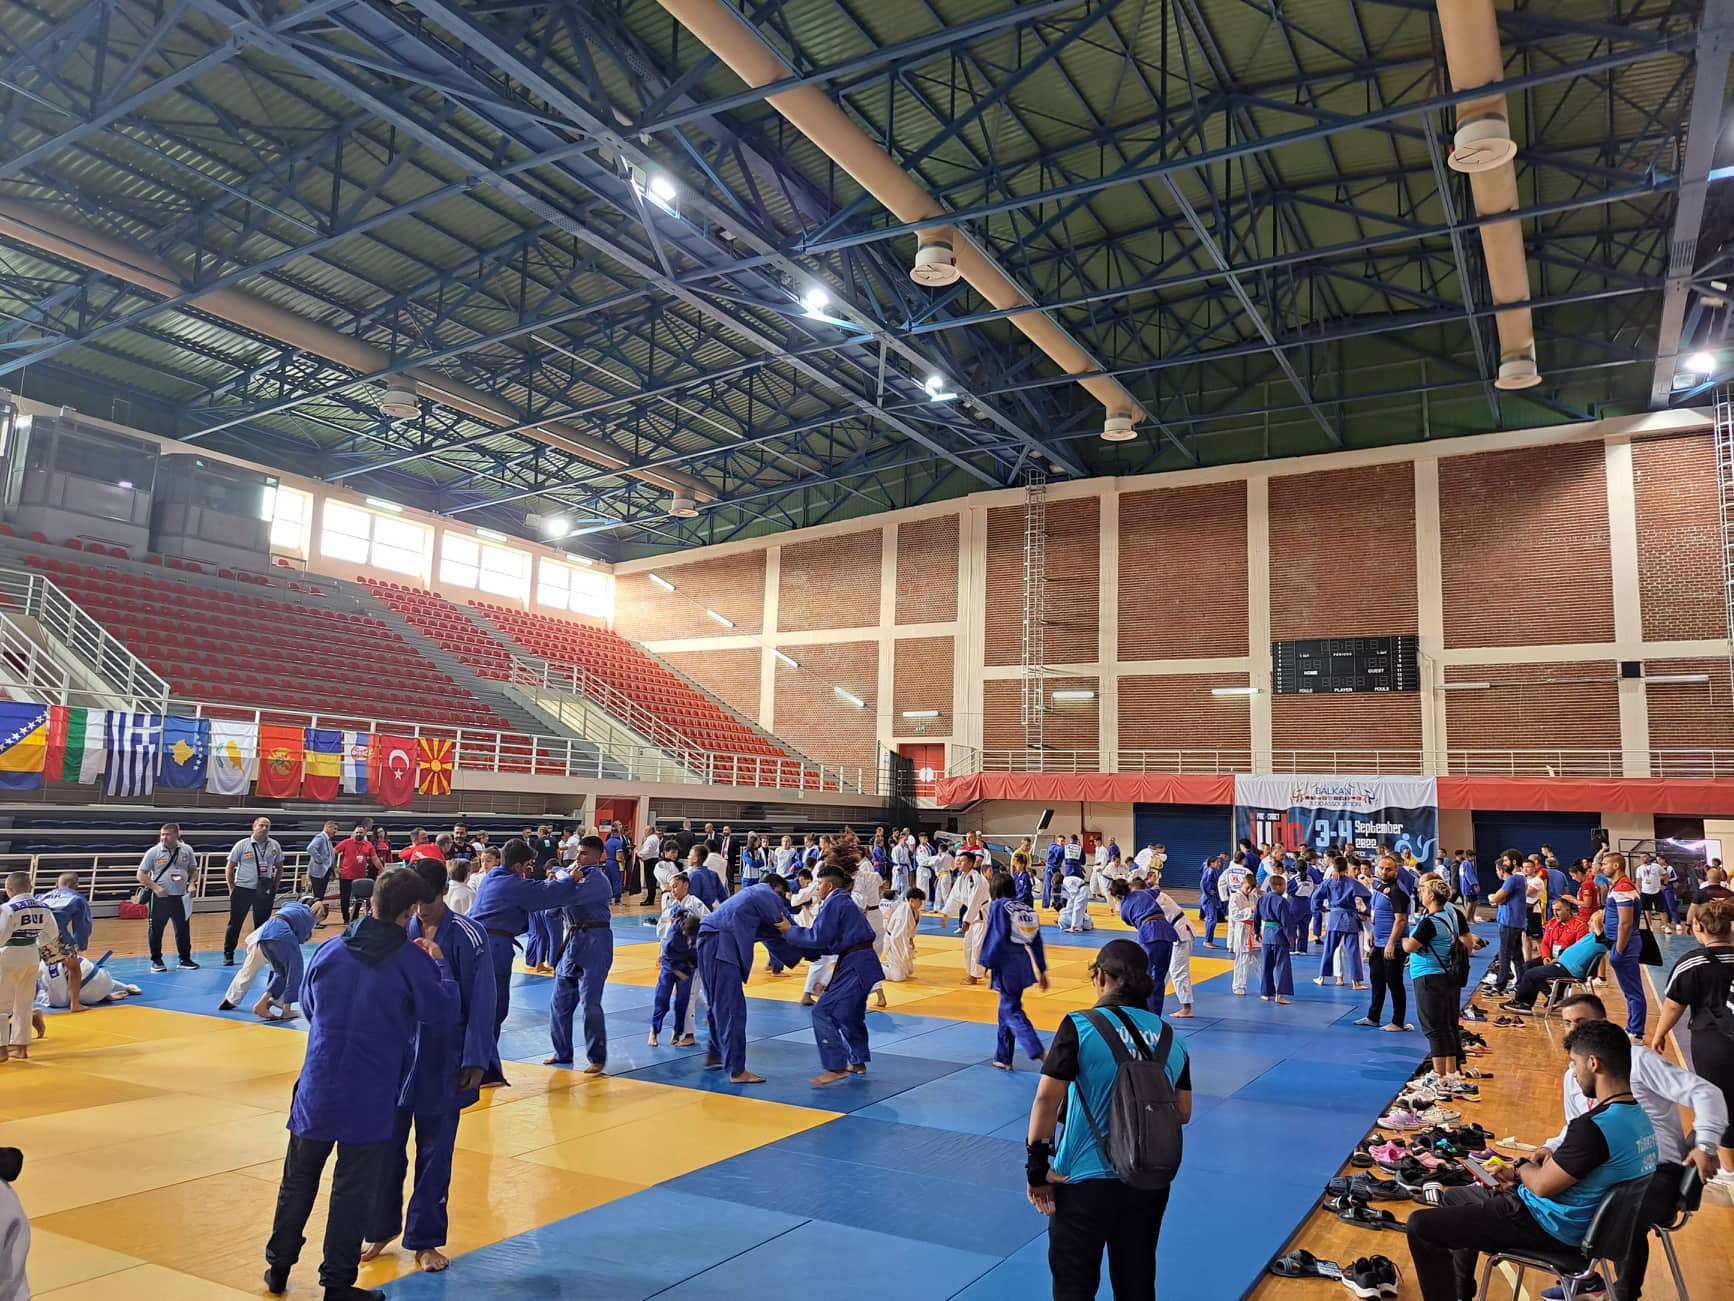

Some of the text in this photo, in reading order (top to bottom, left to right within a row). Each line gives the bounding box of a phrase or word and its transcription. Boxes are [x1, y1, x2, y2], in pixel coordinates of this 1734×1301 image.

[1315, 787, 1352, 795] BALKAN
[1355, 820, 1403, 837] September
[1355, 838, 1377, 849] 2022
